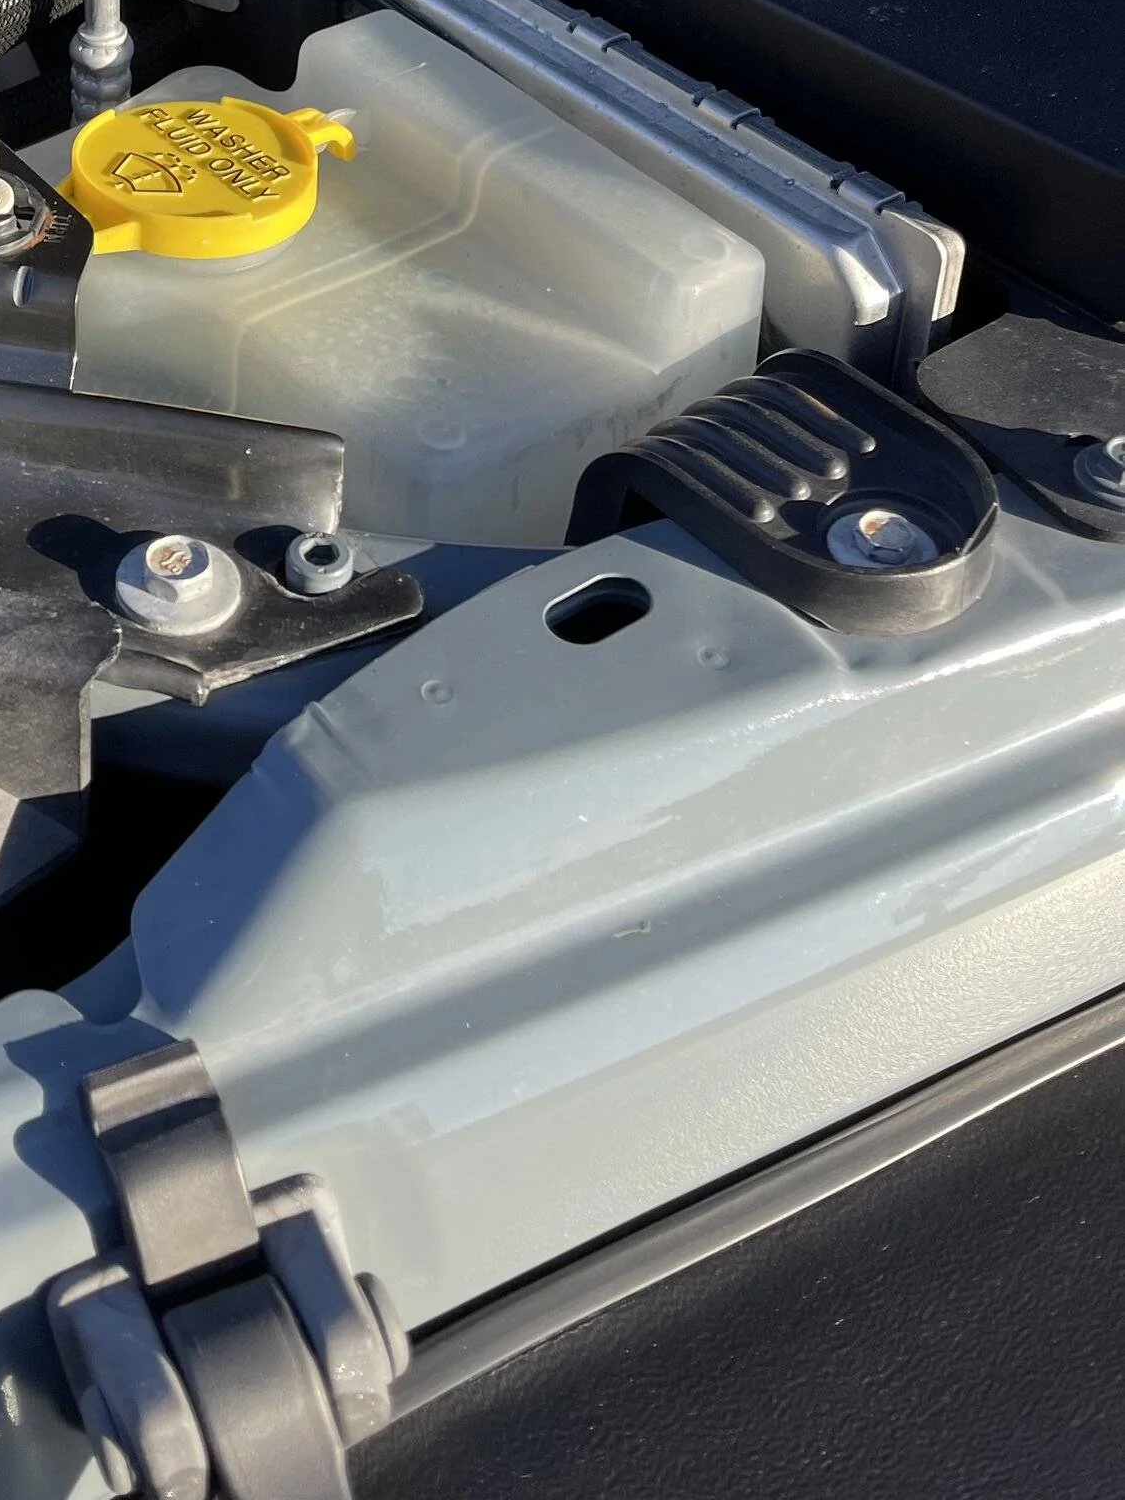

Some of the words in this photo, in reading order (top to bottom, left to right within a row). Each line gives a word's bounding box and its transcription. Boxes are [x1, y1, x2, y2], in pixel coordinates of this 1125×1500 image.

[138, 107, 212, 158] FLUID
[206, 156, 281, 203] ONLY
[186, 108, 291, 183] WASHER
